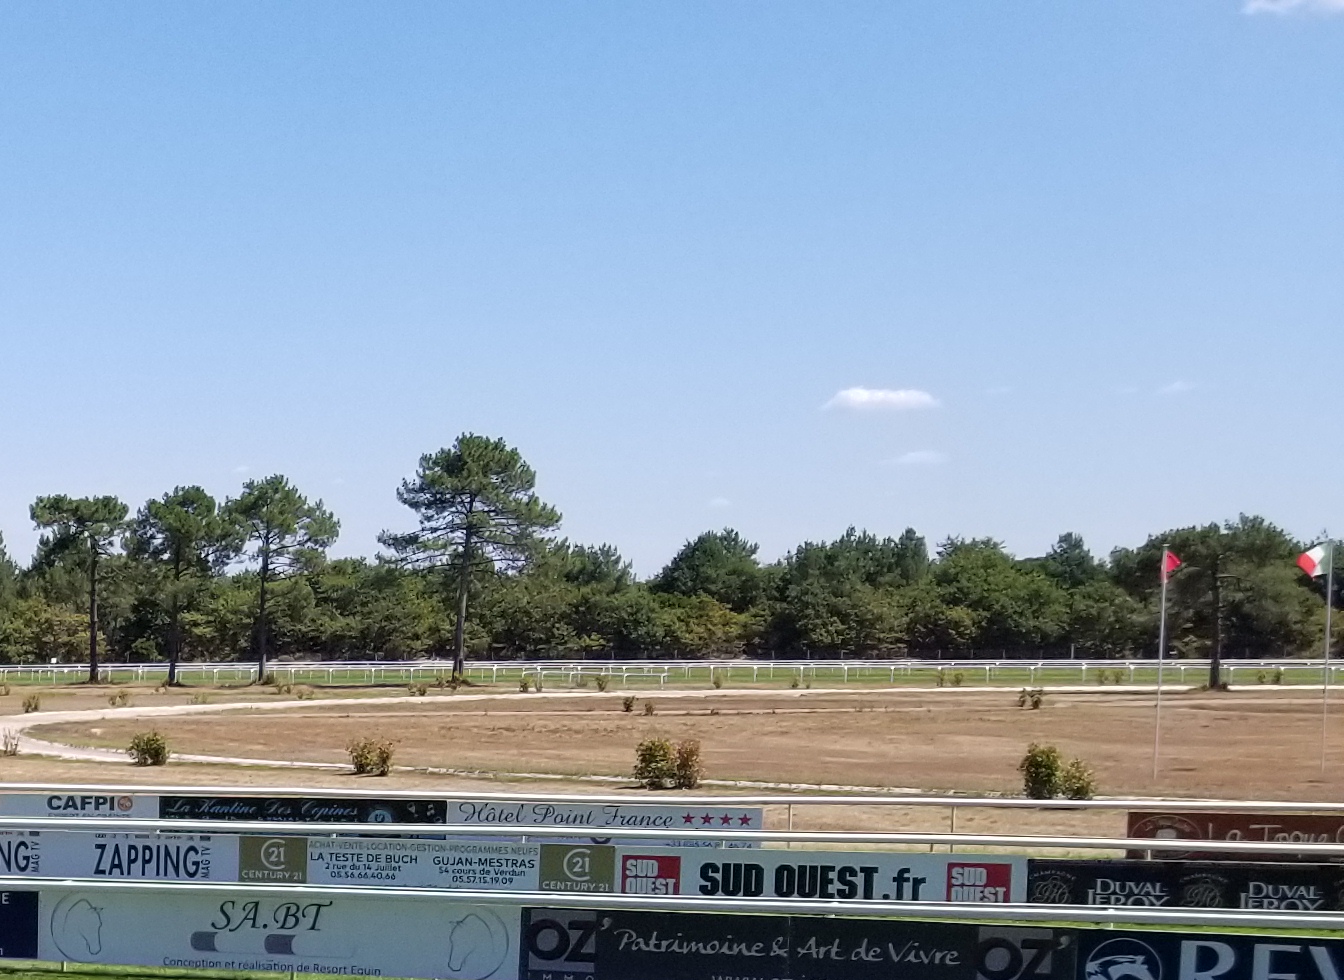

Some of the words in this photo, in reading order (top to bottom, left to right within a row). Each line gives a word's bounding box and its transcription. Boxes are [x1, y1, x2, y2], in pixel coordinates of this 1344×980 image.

[46, 796, 115, 811] CAFPI
[459, 801, 526, 823] Hôtel
[532, 803, 594, 825] Point
[602, 805, 673, 828] France
[93, 843, 201, 879] ZAPPING
[310, 852, 325, 862] LA
[328, 852, 363, 863] TESTE
[366, 853, 382, 863] DE
[385, 854, 418, 865] BUCH
[349, 863, 360, 871] du
[362, 864, 372, 872] 14
[375, 863, 402, 872] Juillet
[432, 856, 536, 869] GUJAN-MESTRAS
[242, 870, 291, 881] CENTURY
[293, 871, 302, 881] 21
[438, 867, 450, 875] 54
[479, 868, 492, 876] de
[494, 869, 526, 878] Verdun
[625, 859, 659, 877] SUD
[951, 867, 988, 886] SUD
[542, 881, 597, 892] CENTURY
[598, 883, 609, 893] 21
[625, 877, 676, 895] OUEST
[699, 862, 764, 897] SUD
[774, 864, 927, 901] OUEST.fr
[951, 886, 1007, 903] OUEST
[211, 900, 333, 932] SA.BT
[613, 928, 766, 957] Patrimoine
[770, 936, 789, 957] &
[797, 936, 847, 960] Art
[850, 938, 884, 962] de
[888, 940, 962, 965] Vivre
[163, 956, 222, 970] Conception
[224, 960, 236, 970] et
[238, 960, 294, 973] réalisation
[296, 963, 311, 973] de
[313, 963, 348, 976] Resort
